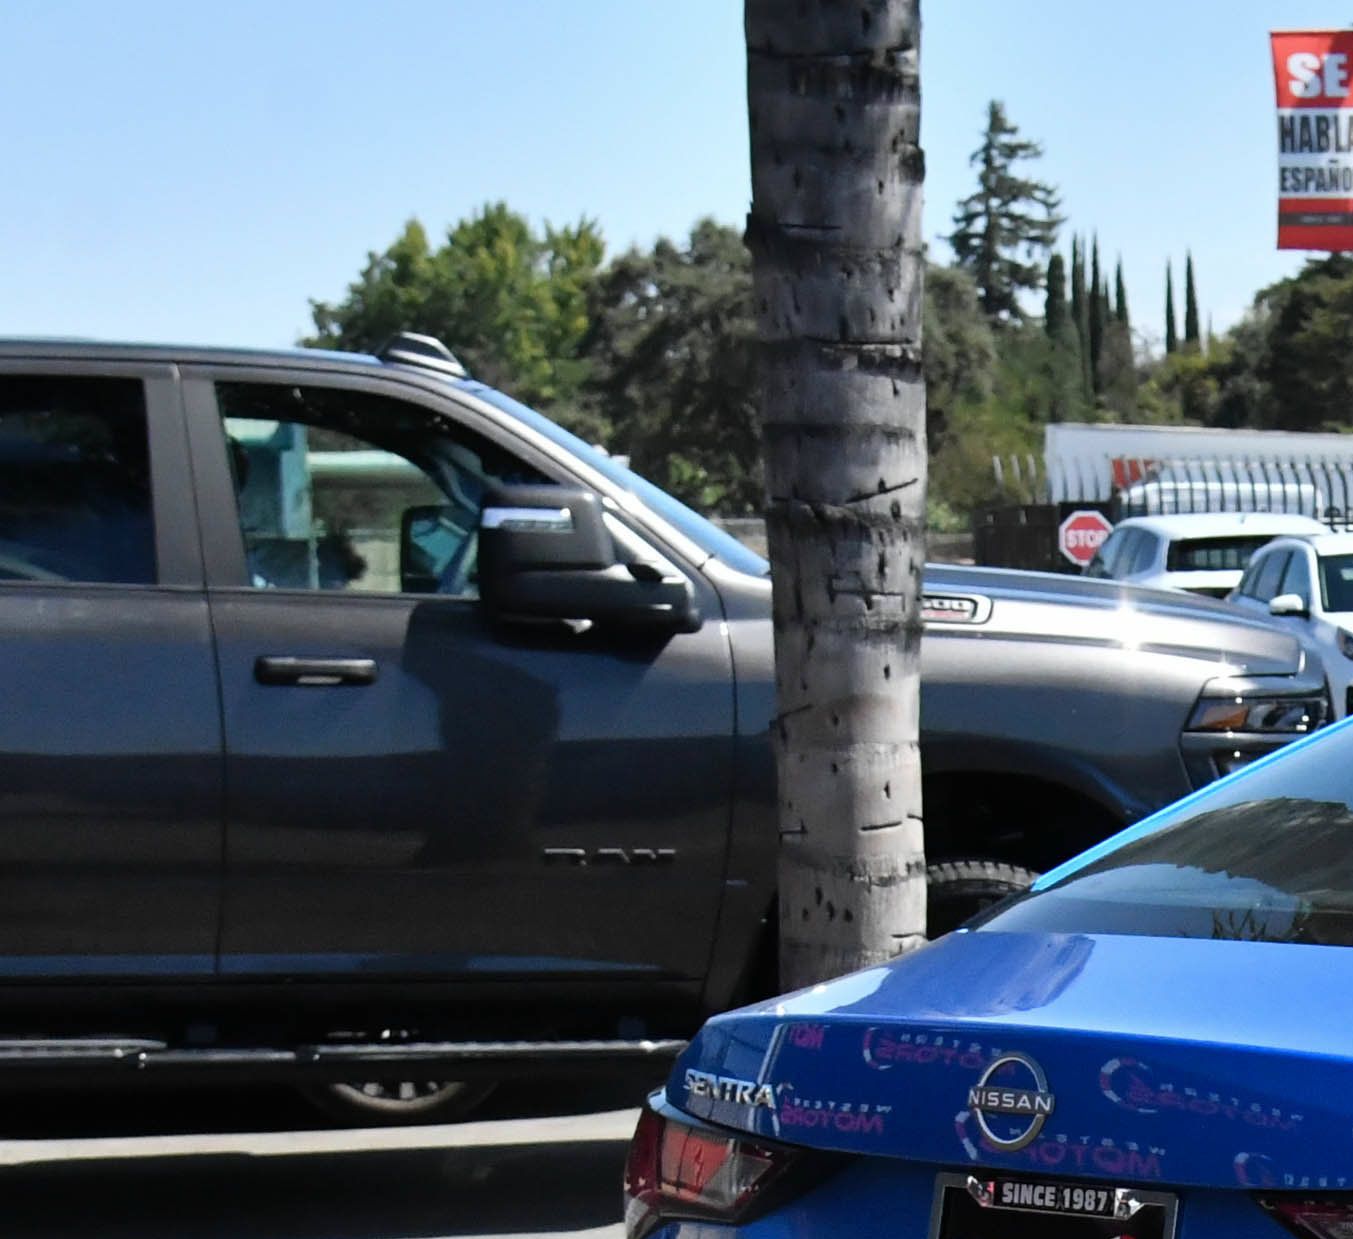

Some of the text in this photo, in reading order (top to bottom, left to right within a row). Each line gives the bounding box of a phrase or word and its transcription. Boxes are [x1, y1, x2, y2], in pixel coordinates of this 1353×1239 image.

[1287, 52, 1349, 99] SE
[683, 1068, 777, 1110] SENTRA
[968, 1088, 1052, 1113] NISSAN
[1001, 1181, 1108, 1212] SINCE 1987
